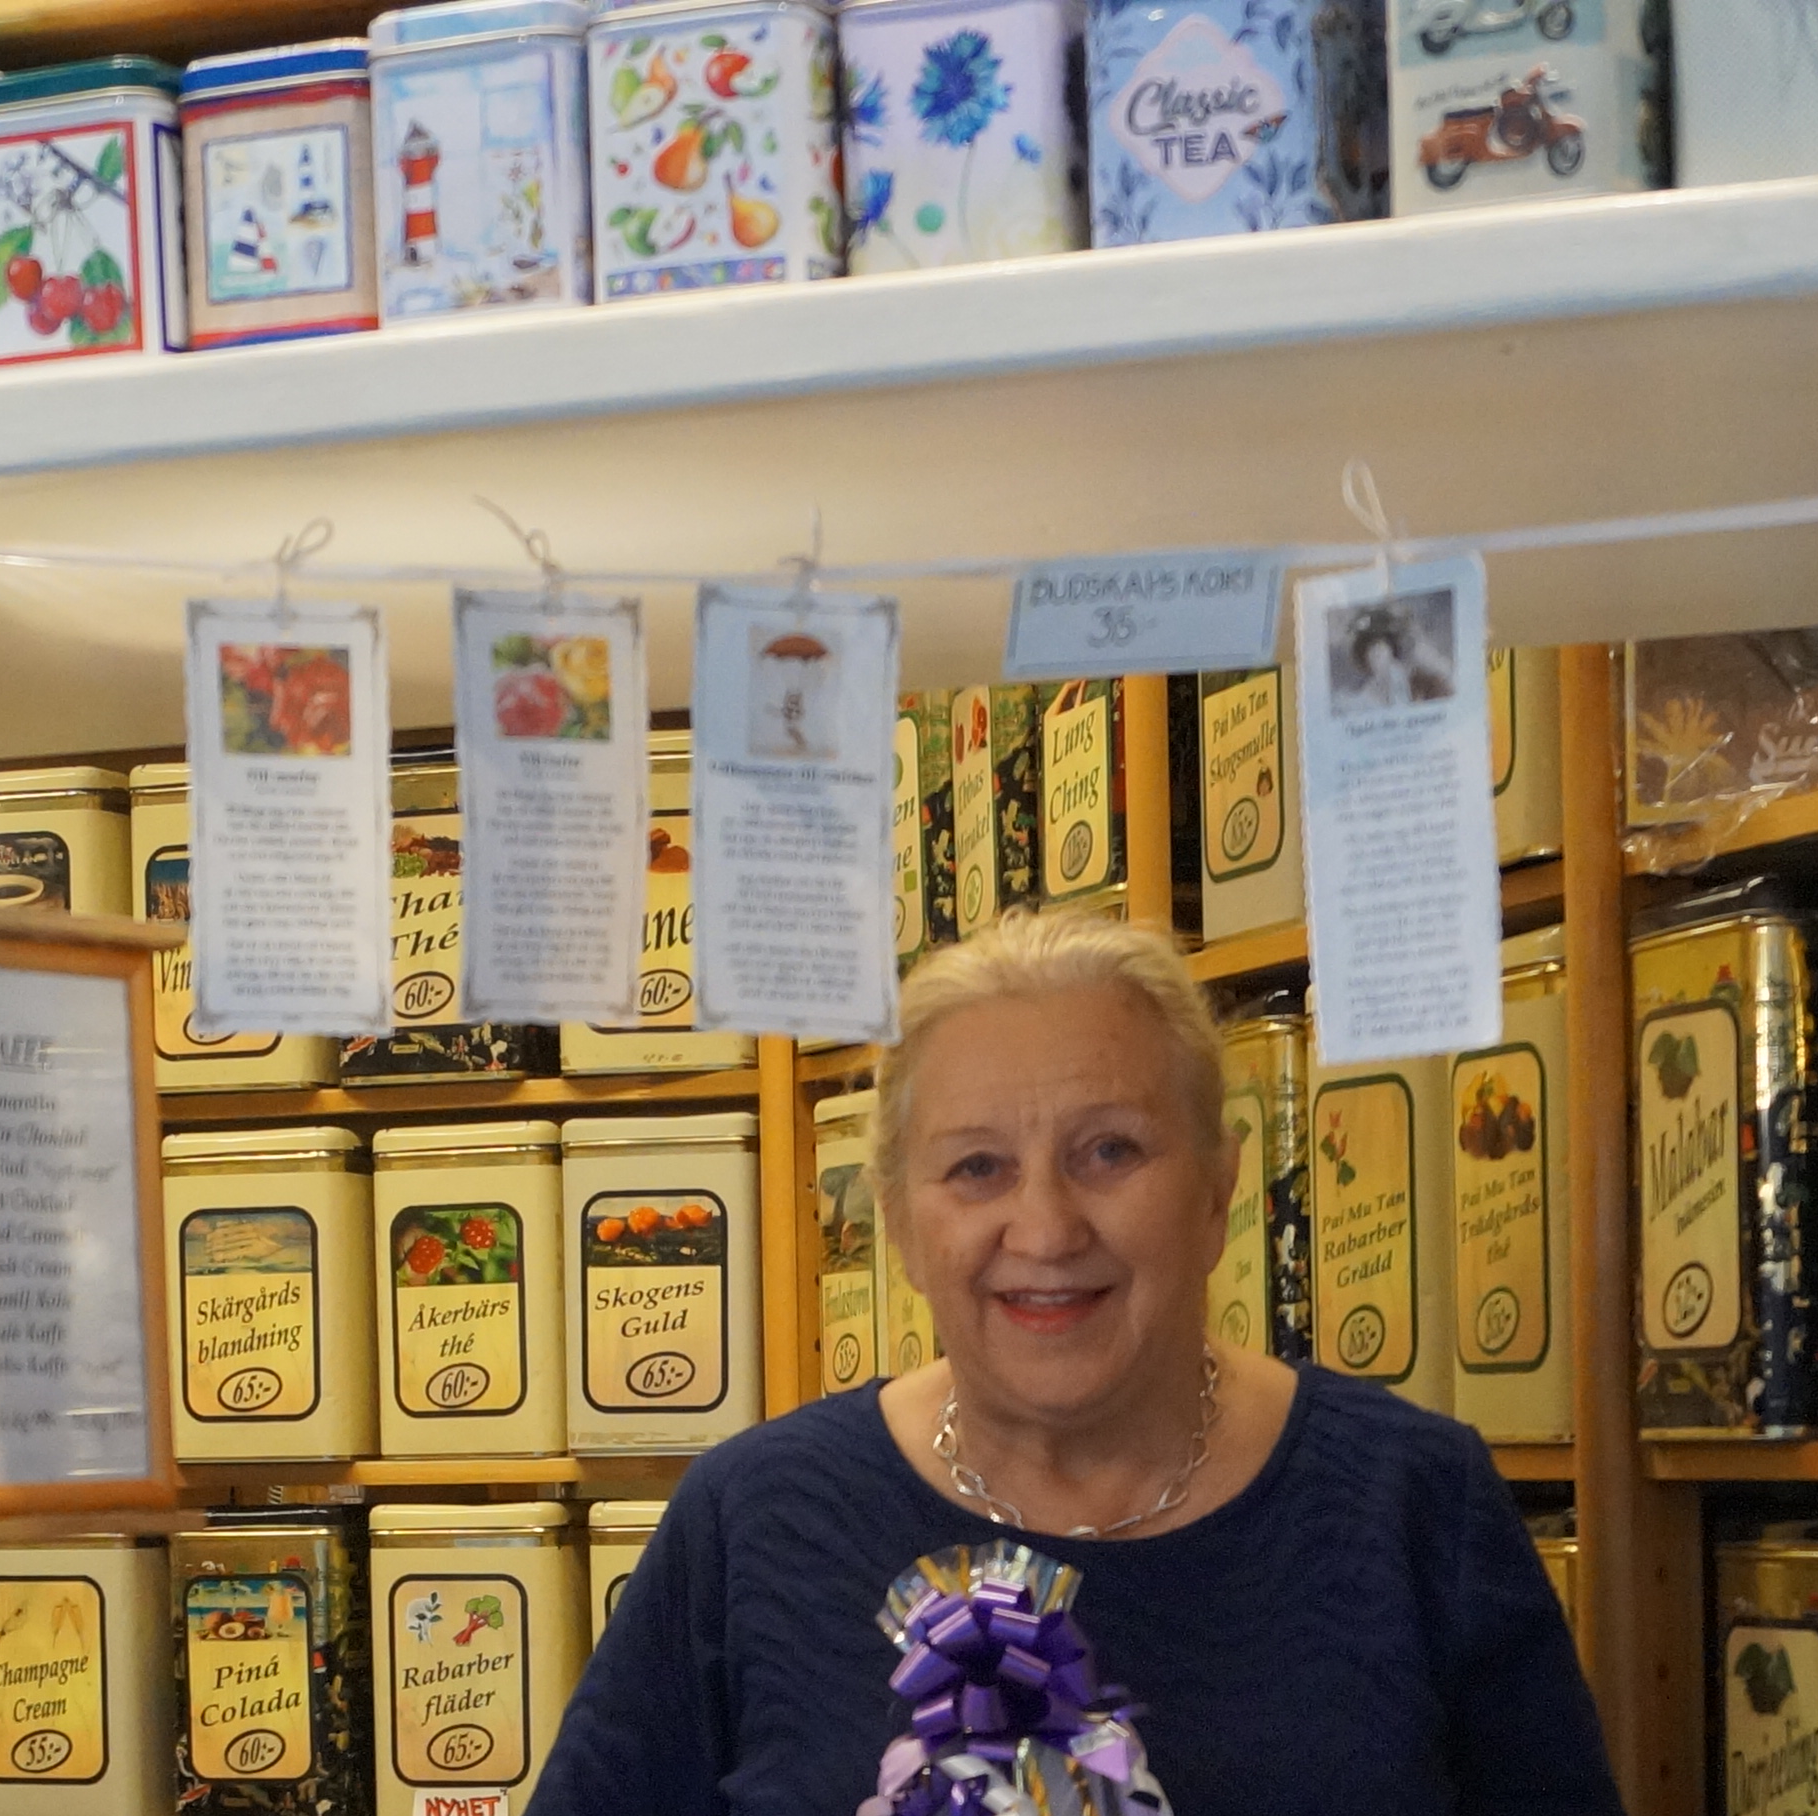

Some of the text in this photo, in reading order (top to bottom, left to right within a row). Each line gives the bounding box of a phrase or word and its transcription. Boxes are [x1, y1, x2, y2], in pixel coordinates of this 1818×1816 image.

[1124, 77, 1262, 141] Classic
[1150, 131, 1240, 169] TEA
[1052, 709, 1096, 767] Lung
[1211, 721, 1276, 788] Skogsmulle
[1050, 766, 1100, 824] Ching
[404, 979, 444, 1010] 60:-
[1324, 1217, 1407, 1263] Rabarber
[1337, 1250, 1393, 1288] Grädd
[196, 1283, 301, 1326] Skärgårds
[595, 1280, 705, 1311] Skogens
[408, 1296, 510, 1332] Åkerbärs
[621, 1309, 688, 1338] Guld
[197, 1321, 303, 1364] blandning
[440, 1335, 475, 1358] thé
[232, 1373, 272, 1403] 65:-
[441, 1368, 479, 1399] 60:-
[643, 1357, 684, 1387] 65:-
[214, 1655, 280, 1690] Piná
[402, 1651, 515, 1690] Rabarber
[13, 1696, 68, 1724] Cream
[200, 1689, 302, 1727] Colada
[423, 1688, 496, 1725] fläder
[25, 1736, 62, 1767] 55:-
[239, 1736, 276, 1767] 60:-
[443, 1732, 483, 1763] 65:-
